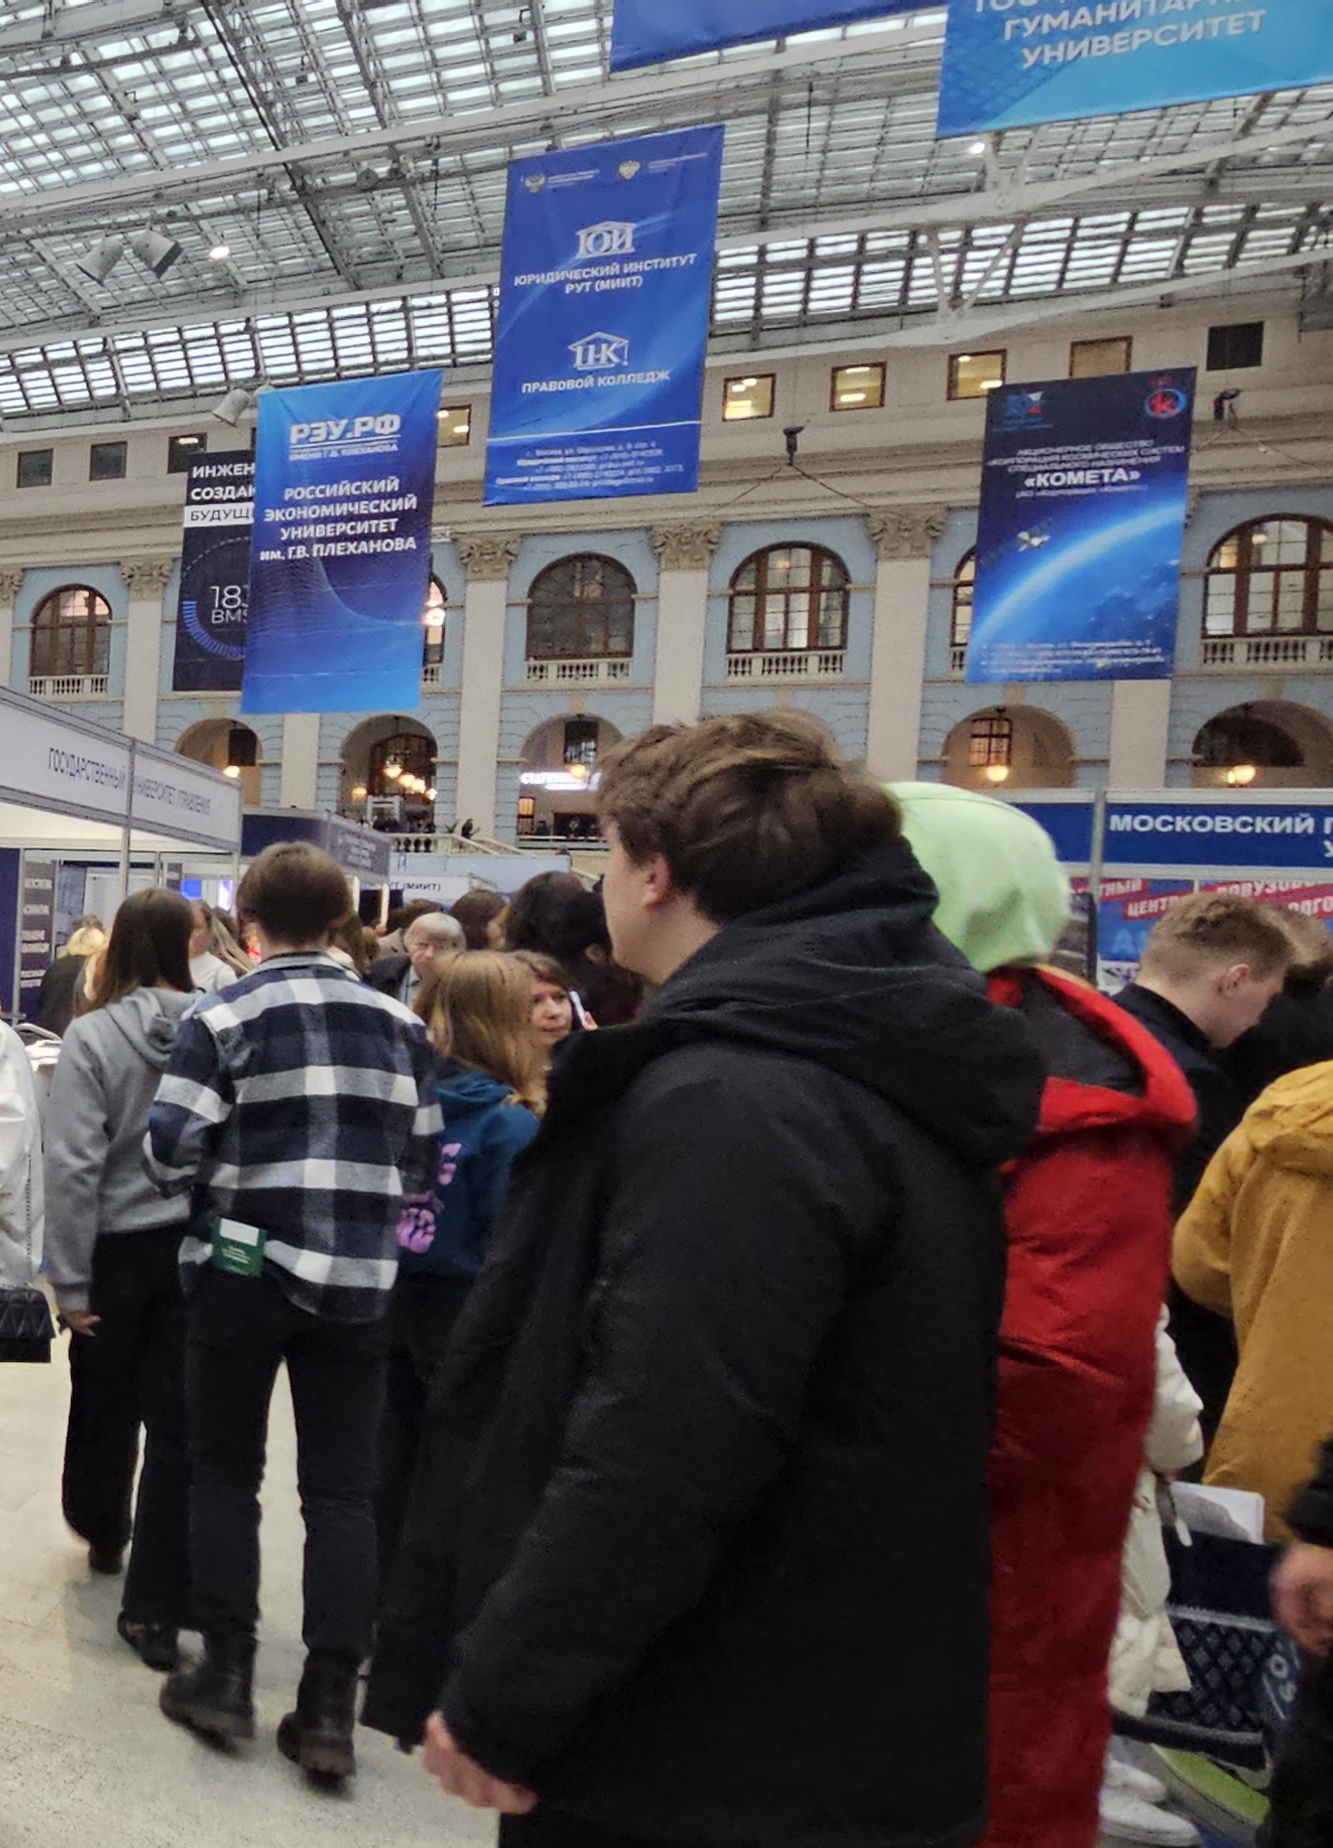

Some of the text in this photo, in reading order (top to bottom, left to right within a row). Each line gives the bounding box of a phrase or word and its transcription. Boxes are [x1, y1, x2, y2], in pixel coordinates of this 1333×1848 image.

[1021, 9, 1267, 69] УНИВЕРСИТЕТ
[514, 253, 698, 286] ЮРИДИЧЕСКИЙ ИНСТИТУТ
[565, 275, 643, 294] РУТ (МИИТ)
[521, 369, 671, 394] ПРАВОВОЙ КОЛЛЕДЖ
[289, 413, 401, 444] РЭУ.РФ
[192, 462, 256, 478] ИНЖЕН
[1024, 468, 1141, 487] «КОМЕТА»
[284, 476, 400, 500] РОССИЙСКИЙ
[190, 508, 251, 522] БУДУЩ
[264, 495, 417, 522] ЭКОНОМИЧЕСКИЙ
[280, 518, 399, 540] УНИВЕРСИТЕТ
[313, 537, 417, 557] ПЛЕХАНОВА
[1109, 813, 1315, 834] МОСКОВСКИЙ
